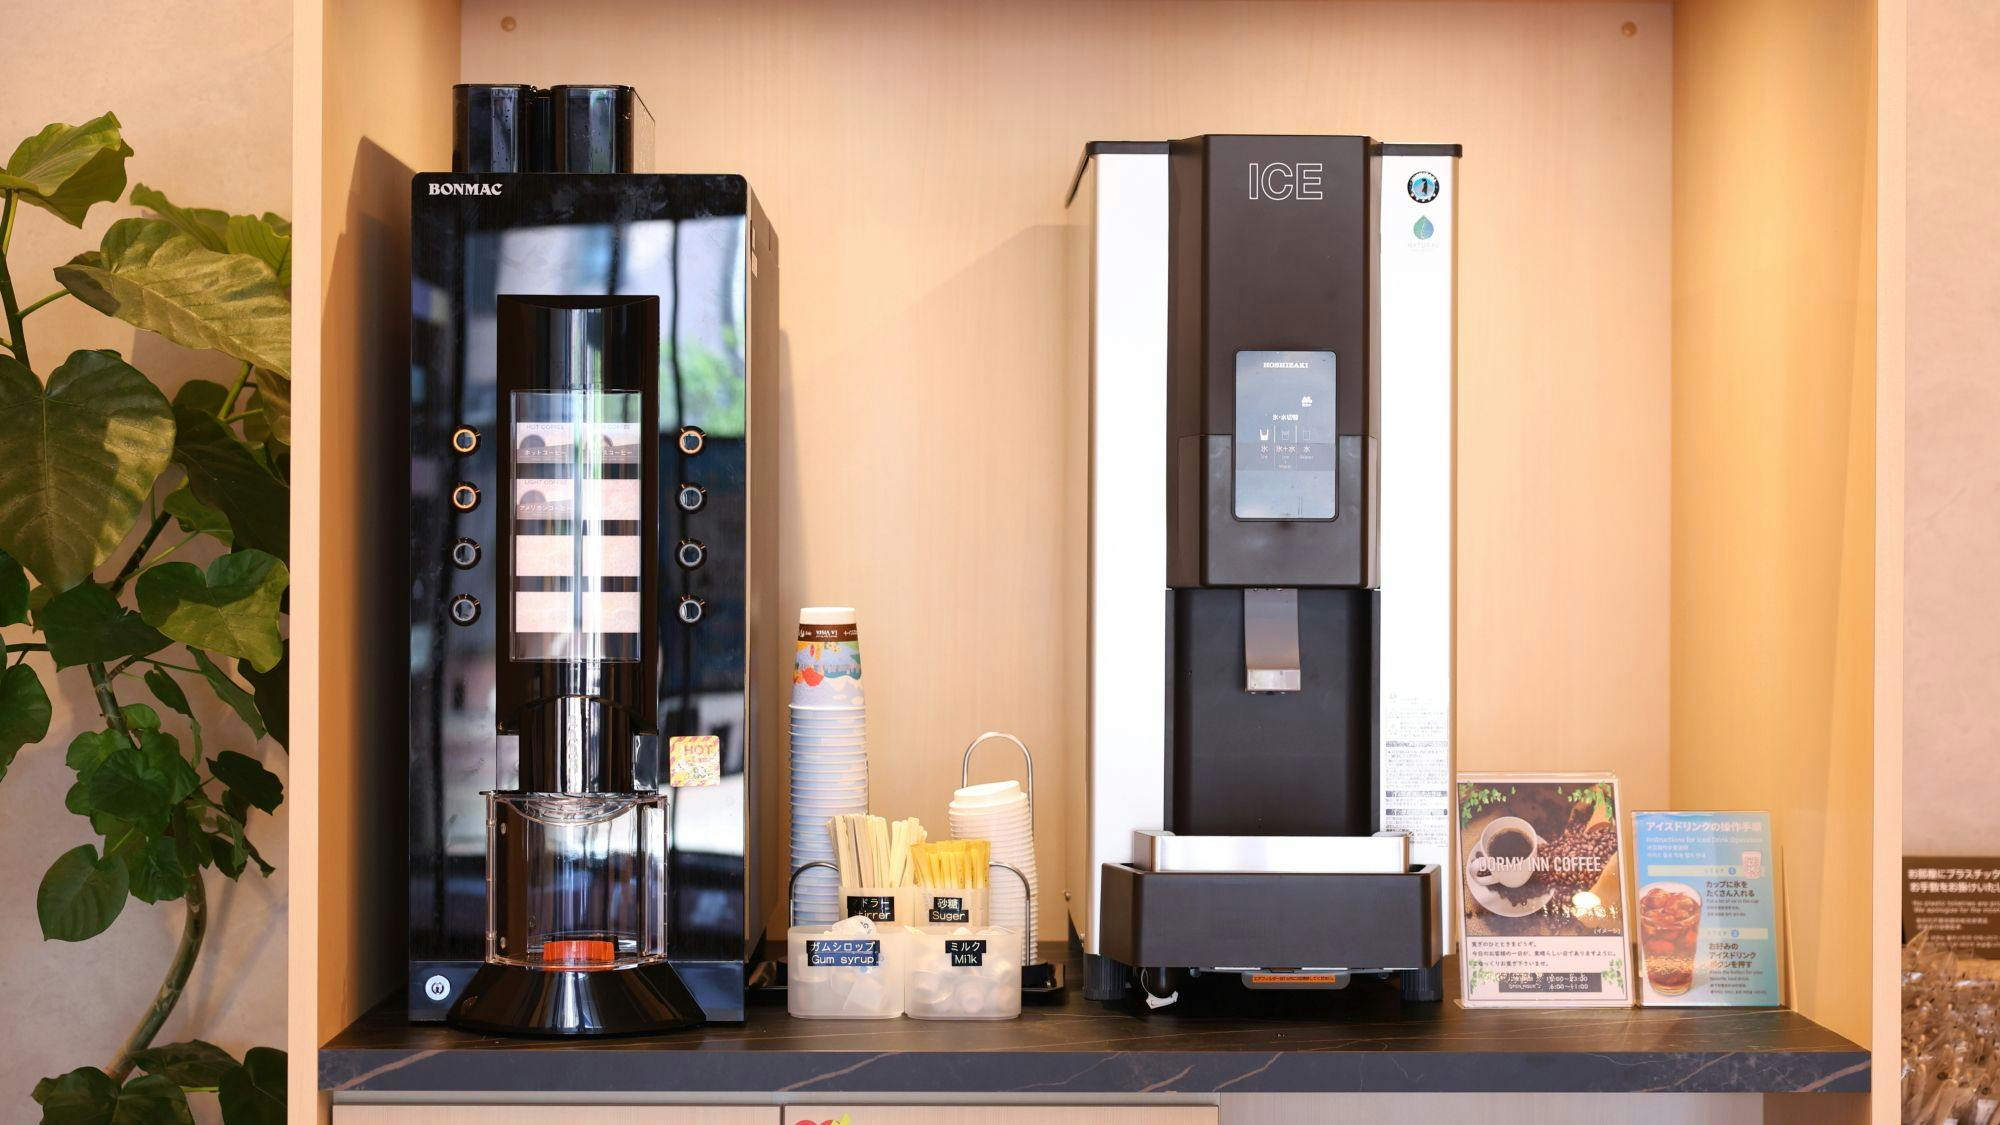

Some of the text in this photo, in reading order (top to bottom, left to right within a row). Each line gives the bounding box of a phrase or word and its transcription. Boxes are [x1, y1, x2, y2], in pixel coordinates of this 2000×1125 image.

[1249, 162, 1323, 200] ICE
[428, 183, 503, 196] BONMAC
[1480, 857, 1602, 872] DORMY INN COFFEE
[938, 898, 959, 909] 砂糖
[853, 911, 890, 920] tirrer
[932, 911, 965, 921] Suger
[810, 942, 875, 952] ガムシロップ
[951, 942, 981, 951] ミルク
[812, 955, 875, 965] Gum syrup
[955, 954, 978, 964] Milk
